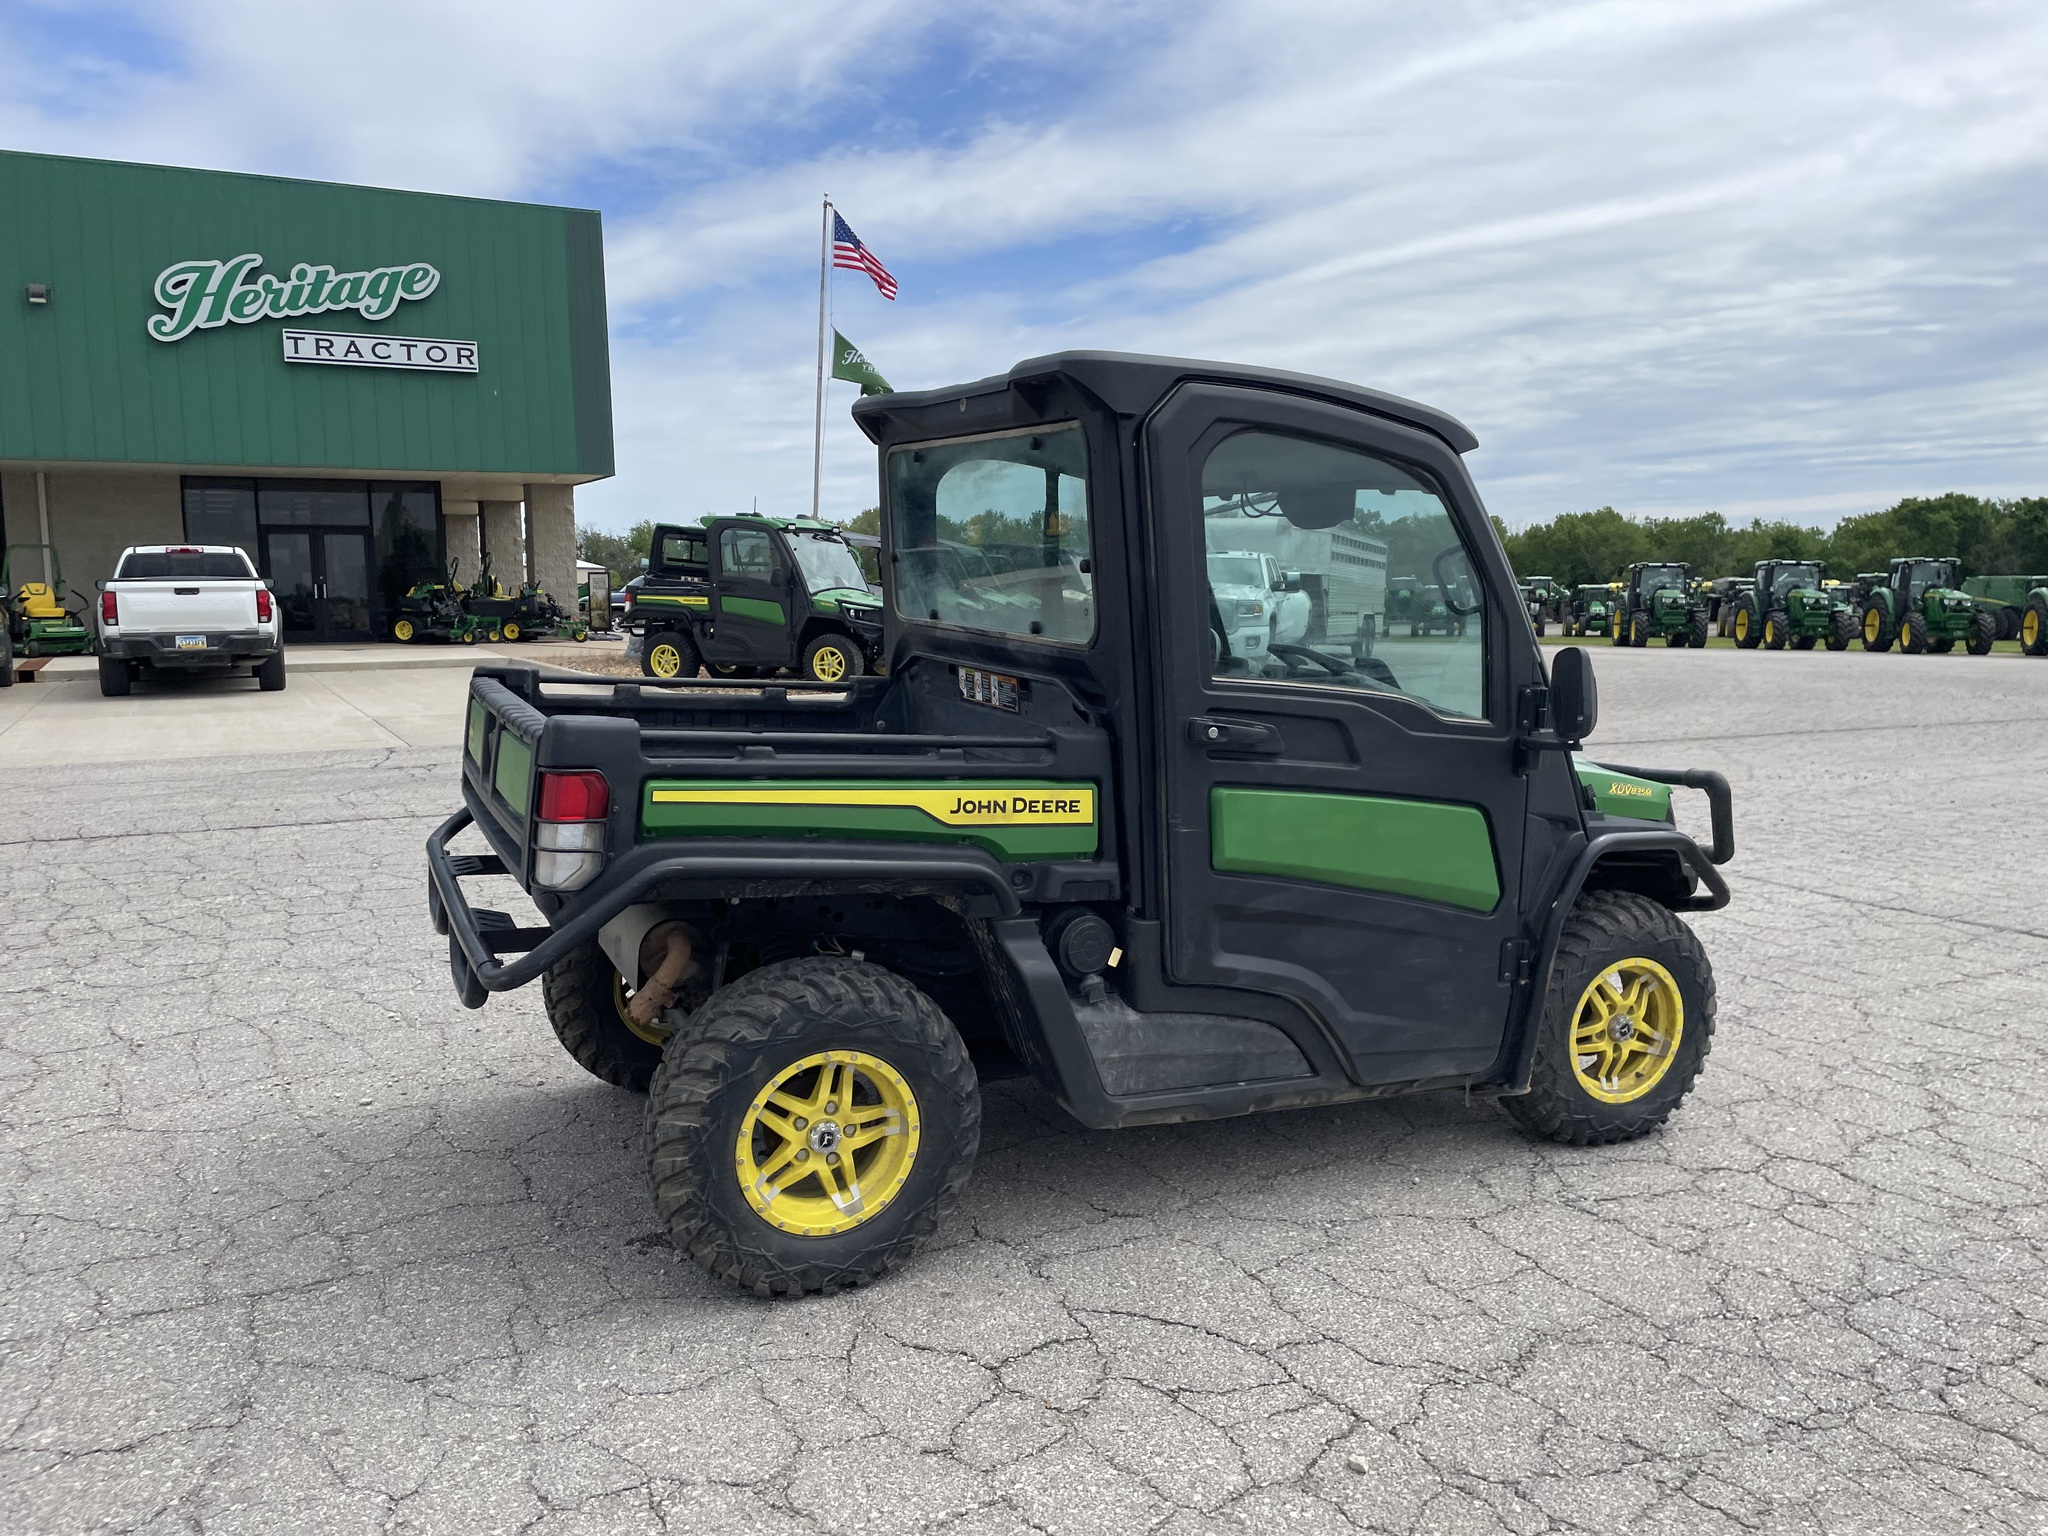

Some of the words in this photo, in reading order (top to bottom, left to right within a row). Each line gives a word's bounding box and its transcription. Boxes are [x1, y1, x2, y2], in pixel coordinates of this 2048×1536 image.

[149, 255, 440, 341] Heritage
[285, 335, 476, 366] TRACTOR
[949, 797, 1007, 815] JOHN
[1012, 797, 1081, 814] DEERE
